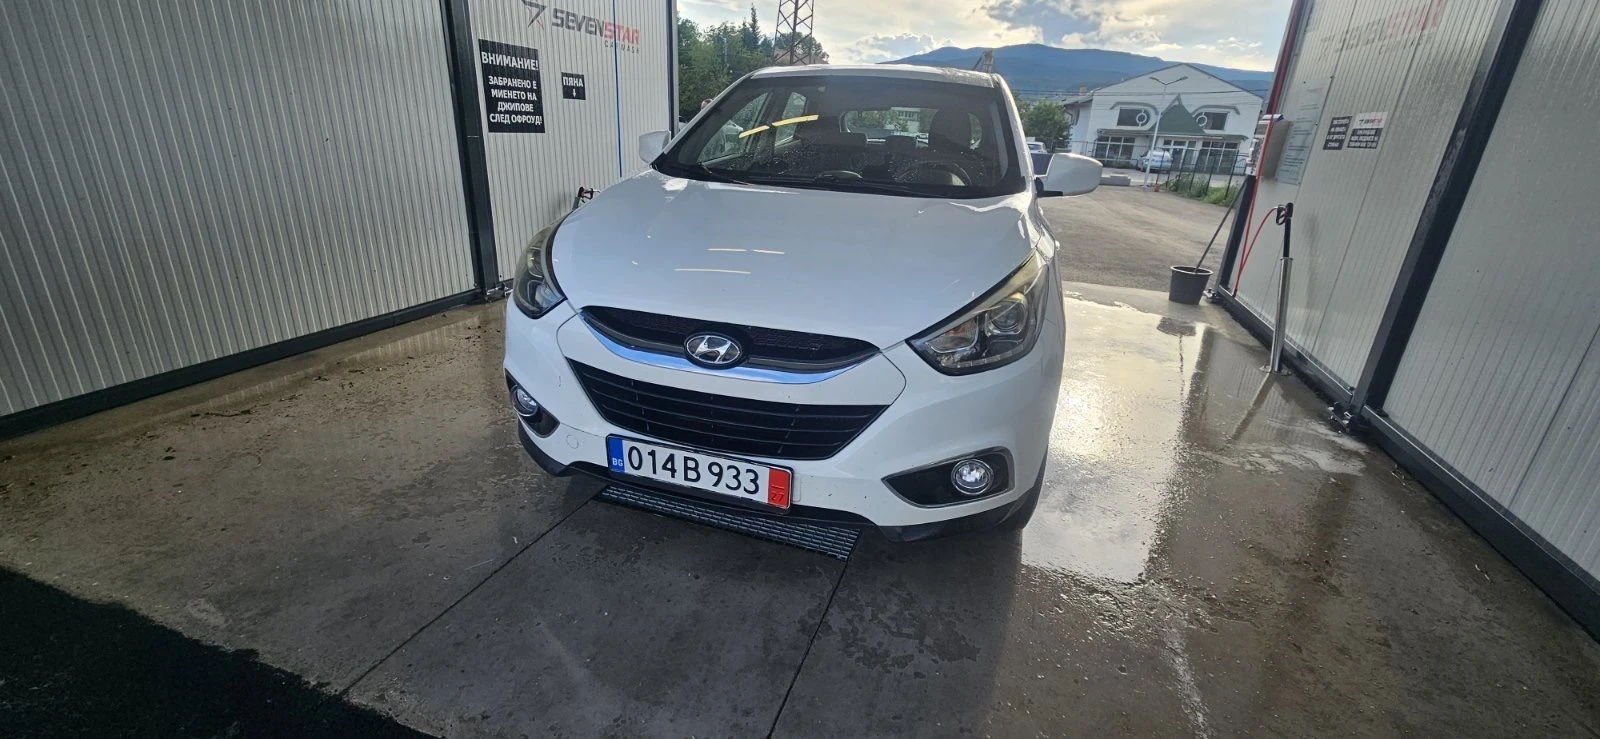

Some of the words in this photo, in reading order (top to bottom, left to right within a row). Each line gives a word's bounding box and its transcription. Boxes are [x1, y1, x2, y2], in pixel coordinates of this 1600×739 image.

[552, 8, 640, 45] SEVENSTAR
[481, 51, 539, 71] ВНИМАНИЕ!
[488, 75, 531, 89] ЗАБРАНЕНО
[532, 80, 537, 90] Е
[562, 76, 584, 87] ПЯНА
[491, 88, 526, 100] МИЕНЕТО
[527, 92, 537, 101] НА
[497, 101, 534, 112] ДЖИПОВЕ
[489, 113, 511, 125] СЛЕД
[511, 114, 543, 126] ОФРОУД!
[612, 457, 623, 467] BG
